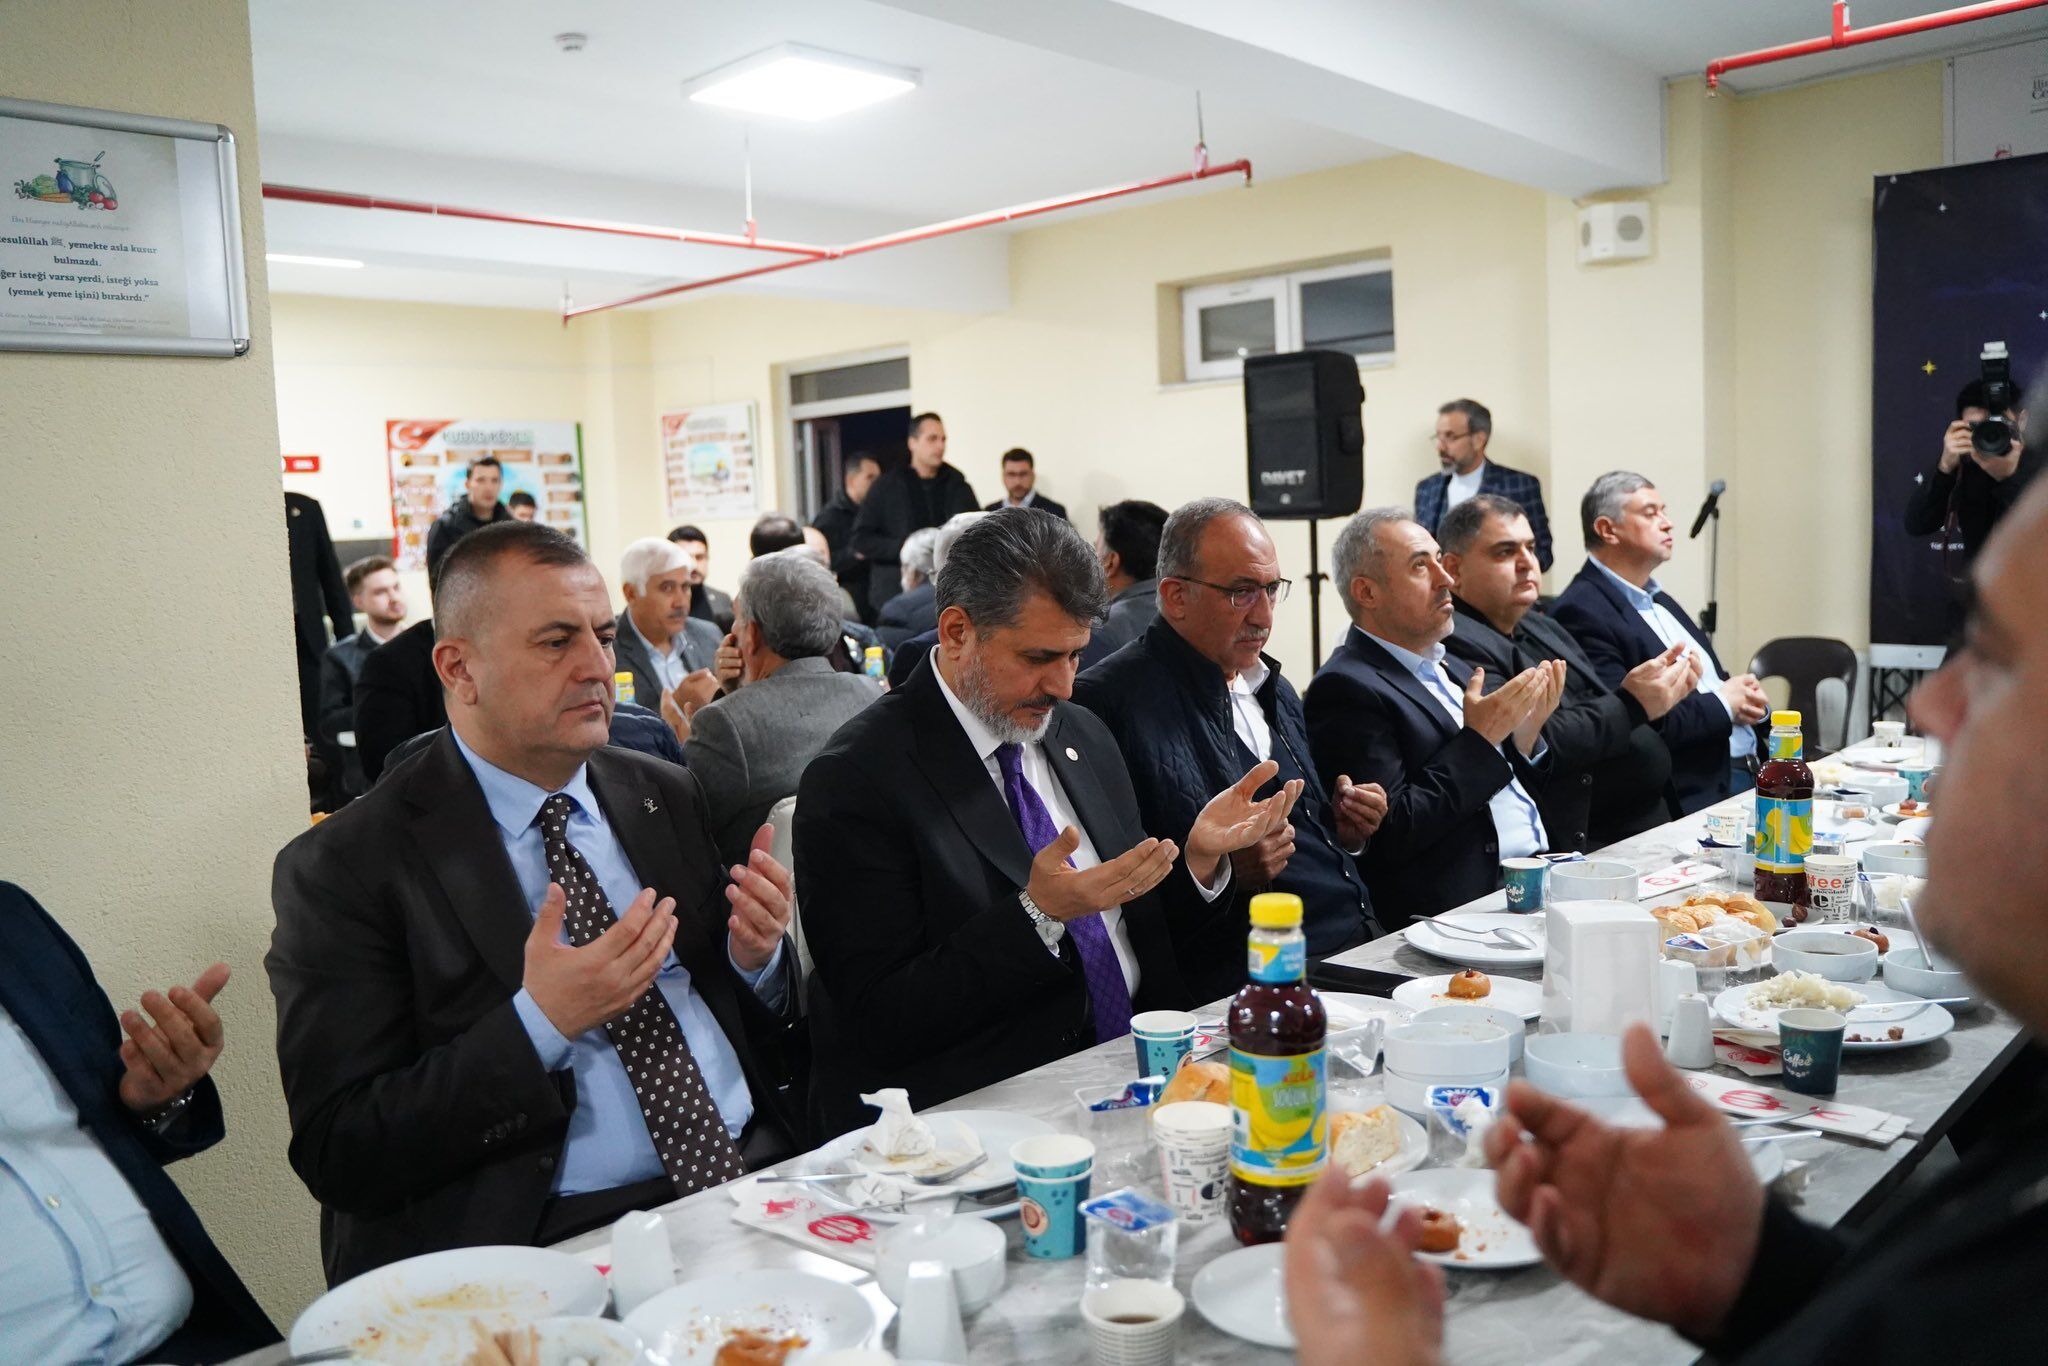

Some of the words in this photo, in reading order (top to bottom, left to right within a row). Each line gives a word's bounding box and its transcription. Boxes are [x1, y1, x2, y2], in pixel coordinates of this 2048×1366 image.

[0, 235, 48, 247] esulûllah
[68, 241, 108, 251] yemekte
[110, 243, 129, 252] asla
[130, 244, 158, 254] kusur
[53, 255, 102, 267] bulmazdı.
[0, 270, 17, 280] ğer
[19, 270, 47, 281] isteği
[49, 274, 76, 282] varsa
[77, 275, 104, 284] yerdi,
[106, 275, 132, 286] isteği
[133, 277, 159, 287] yoksa
[8, 286, 44, 297] (yemek
[47, 290, 73, 299] yeme
[74, 289, 99, 301] işini)
[1783, 1048, 1814, 1068] Coffee
